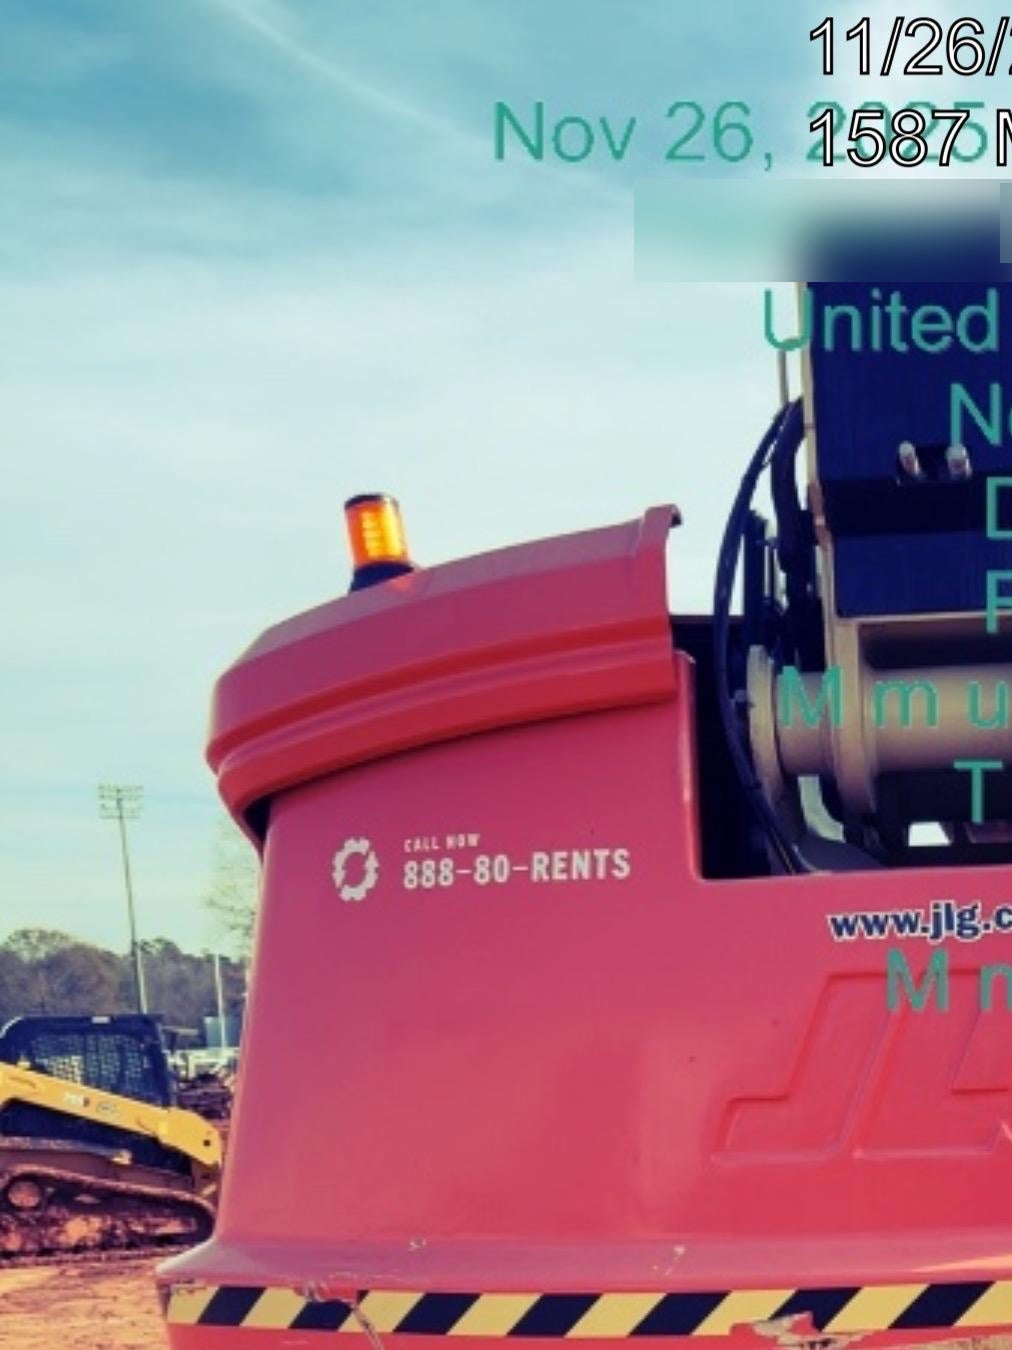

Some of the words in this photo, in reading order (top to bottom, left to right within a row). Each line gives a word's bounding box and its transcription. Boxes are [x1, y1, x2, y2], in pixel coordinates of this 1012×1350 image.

[403, 837, 440, 852] CALL
[446, 834, 480, 848] NOW
[403, 849, 631, 889] 888-80-RENTS
